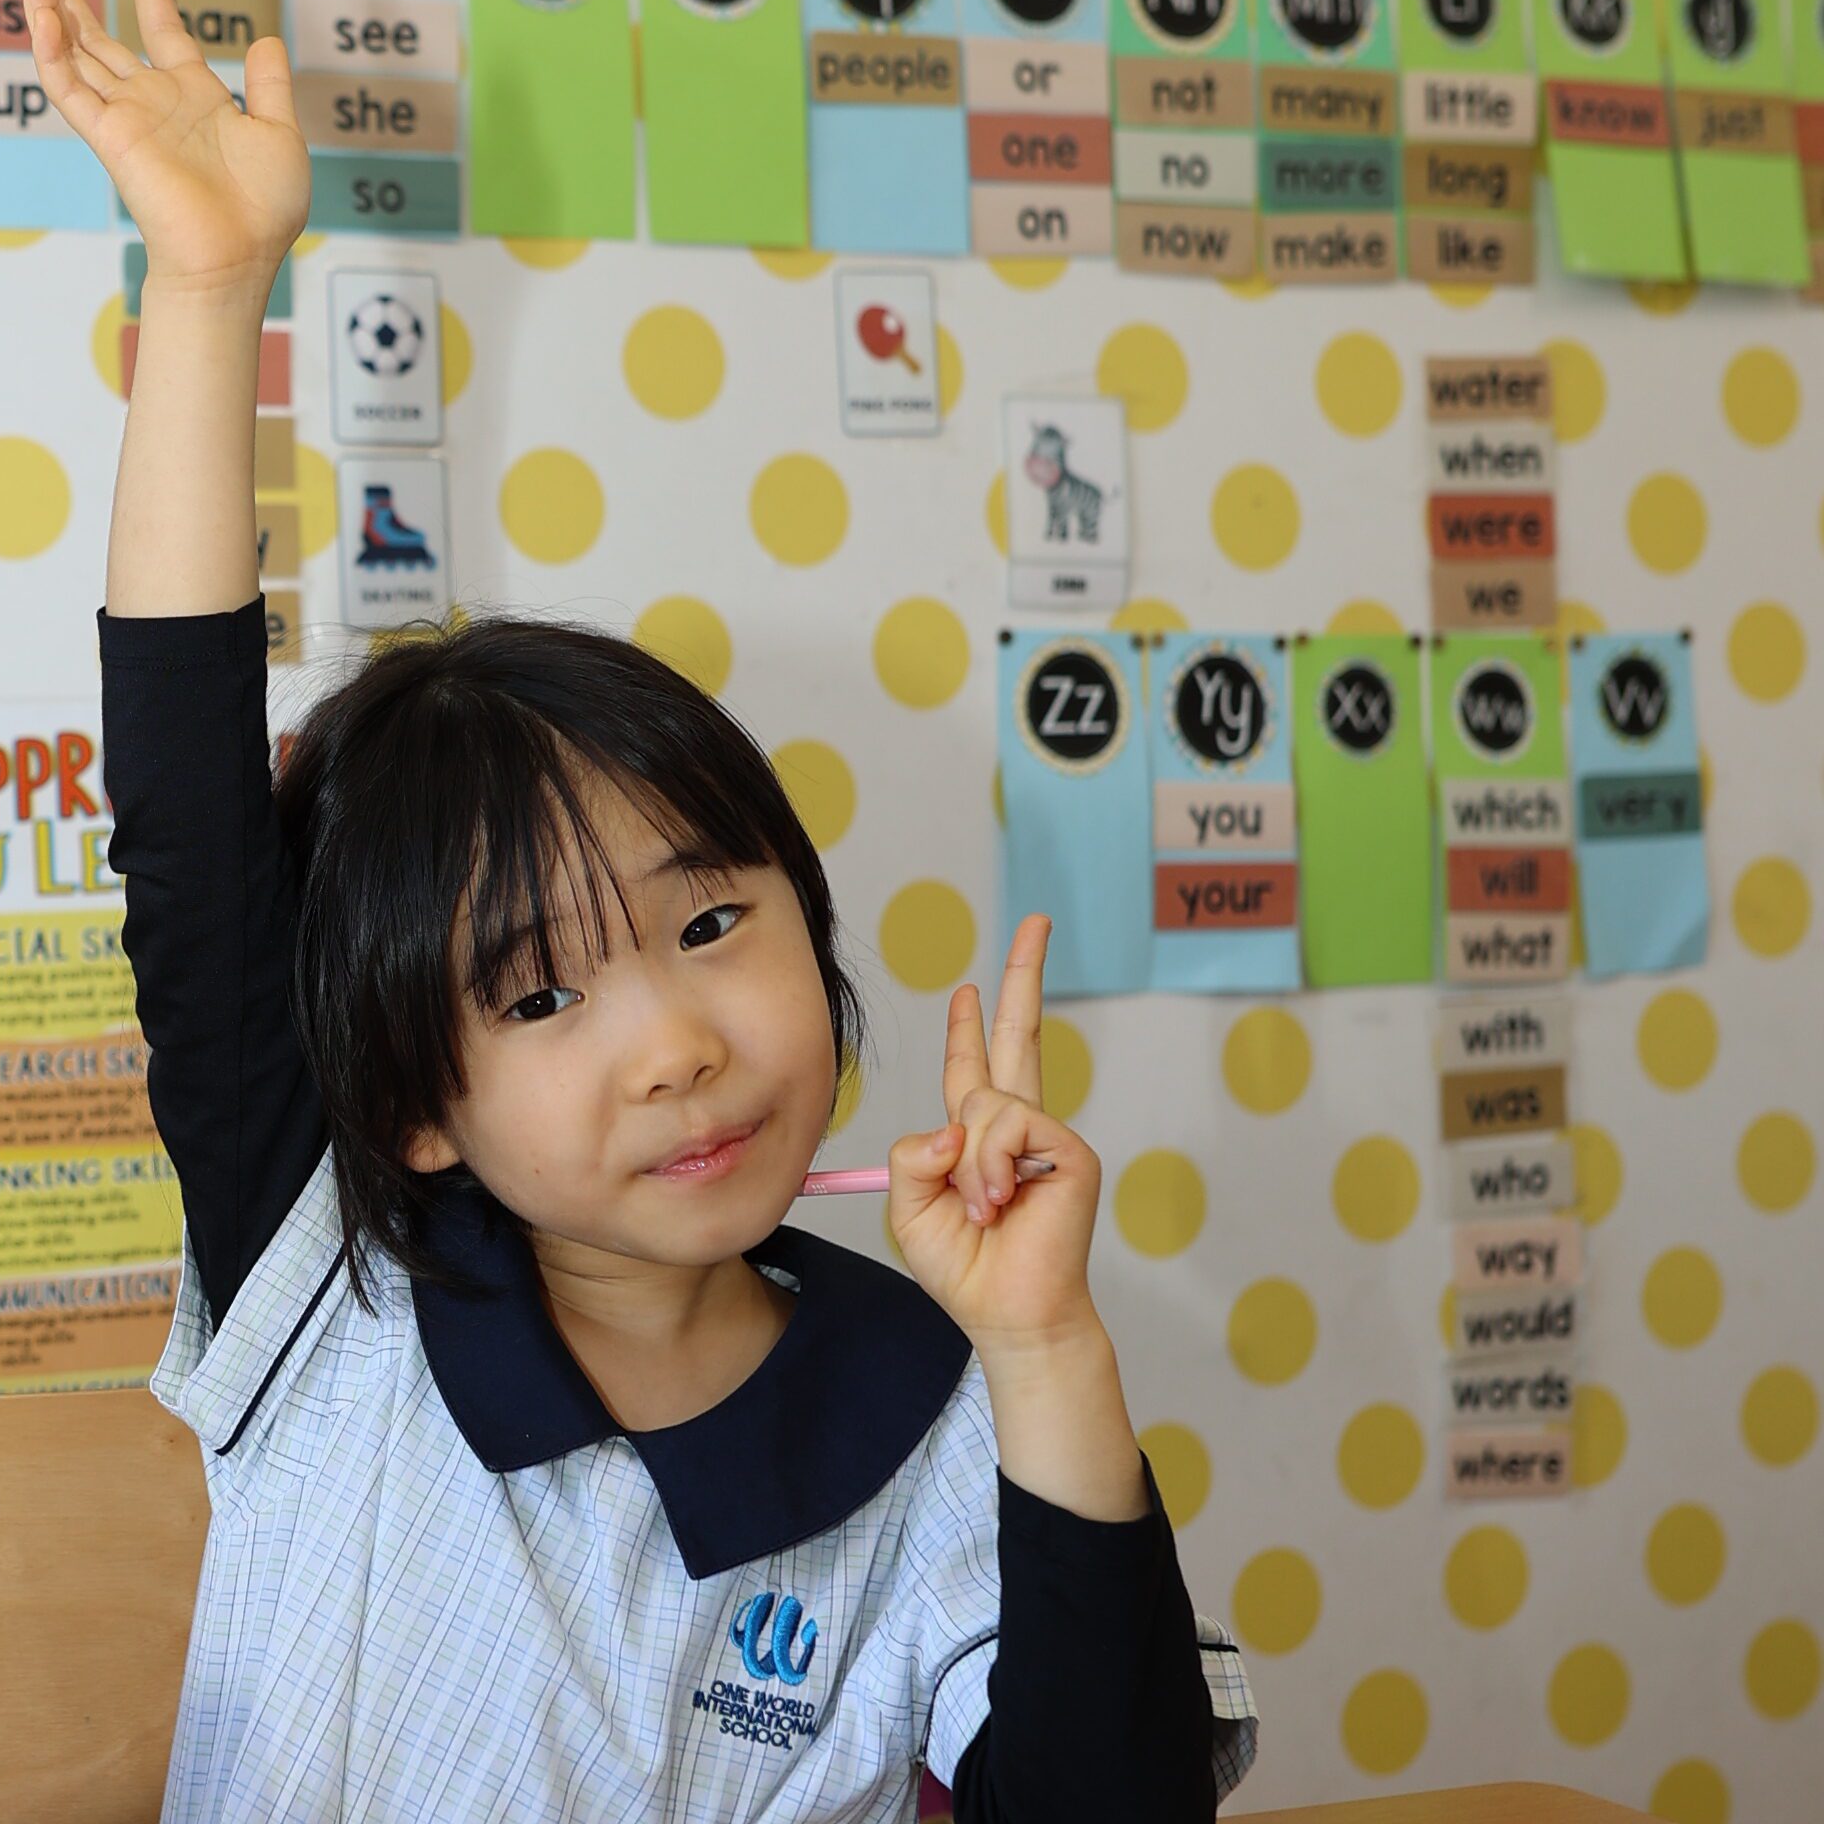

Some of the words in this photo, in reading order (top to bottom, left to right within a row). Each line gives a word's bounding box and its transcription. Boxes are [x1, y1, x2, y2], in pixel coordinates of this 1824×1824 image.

[334, 16, 419, 55] see
[816, 49, 953, 94] people
[1014, 61, 1060, 93] or
[333, 89, 418, 134] she
[1152, 76, 1217, 112] not
[1271, 85, 1383, 128] many
[1426, 78, 1513, 127] little
[1557, 91, 1658, 131] know
[1700, 107, 1765, 144] just
[1002, 134, 1079, 168] one
[1161, 154, 1210, 186] no
[353, 180, 406, 214] so
[1275, 162, 1383, 196] more
[1428, 156, 1508, 207] long
[1018, 207, 1068, 240] on
[1142, 222, 1229, 260] now
[1274, 227, 1386, 266] make
[1437, 230, 1503, 271] like
[1430, 371, 1546, 405] water
[1440, 435, 1542, 475] when
[1441, 508, 1543, 545] were
[1465, 580, 1522, 617] we
[1038, 676, 1109, 736] Zz
[1194, 668, 1254, 757] Yy
[1332, 680, 1388, 733] Xx
[1188, 795, 1264, 844] you
[1454, 788, 1561, 832] which
[1596, 793, 1688, 830] very
[33, 819, 126, 896] LE
[1175, 874, 1274, 920] your
[1480, 860, 1539, 900] will
[1460, 927, 1556, 970] what
[1461, 1009, 1544, 1055] with
[1466, 1097, 1541, 1125] was
[1471, 1157, 1550, 1202] who
[1476, 1239, 1559, 1280] way
[1463, 1299, 1575, 1347] would
[1451, 1371, 1571, 1411] words
[1454, 1444, 1562, 1483] where
[693, 1690, 818, 1736] INTERNATIONAL
[711, 1680, 750, 1704] ONE
[754, 1690, 816, 1719] WORLD
[719, 1718, 792, 1750] SCHOOL
